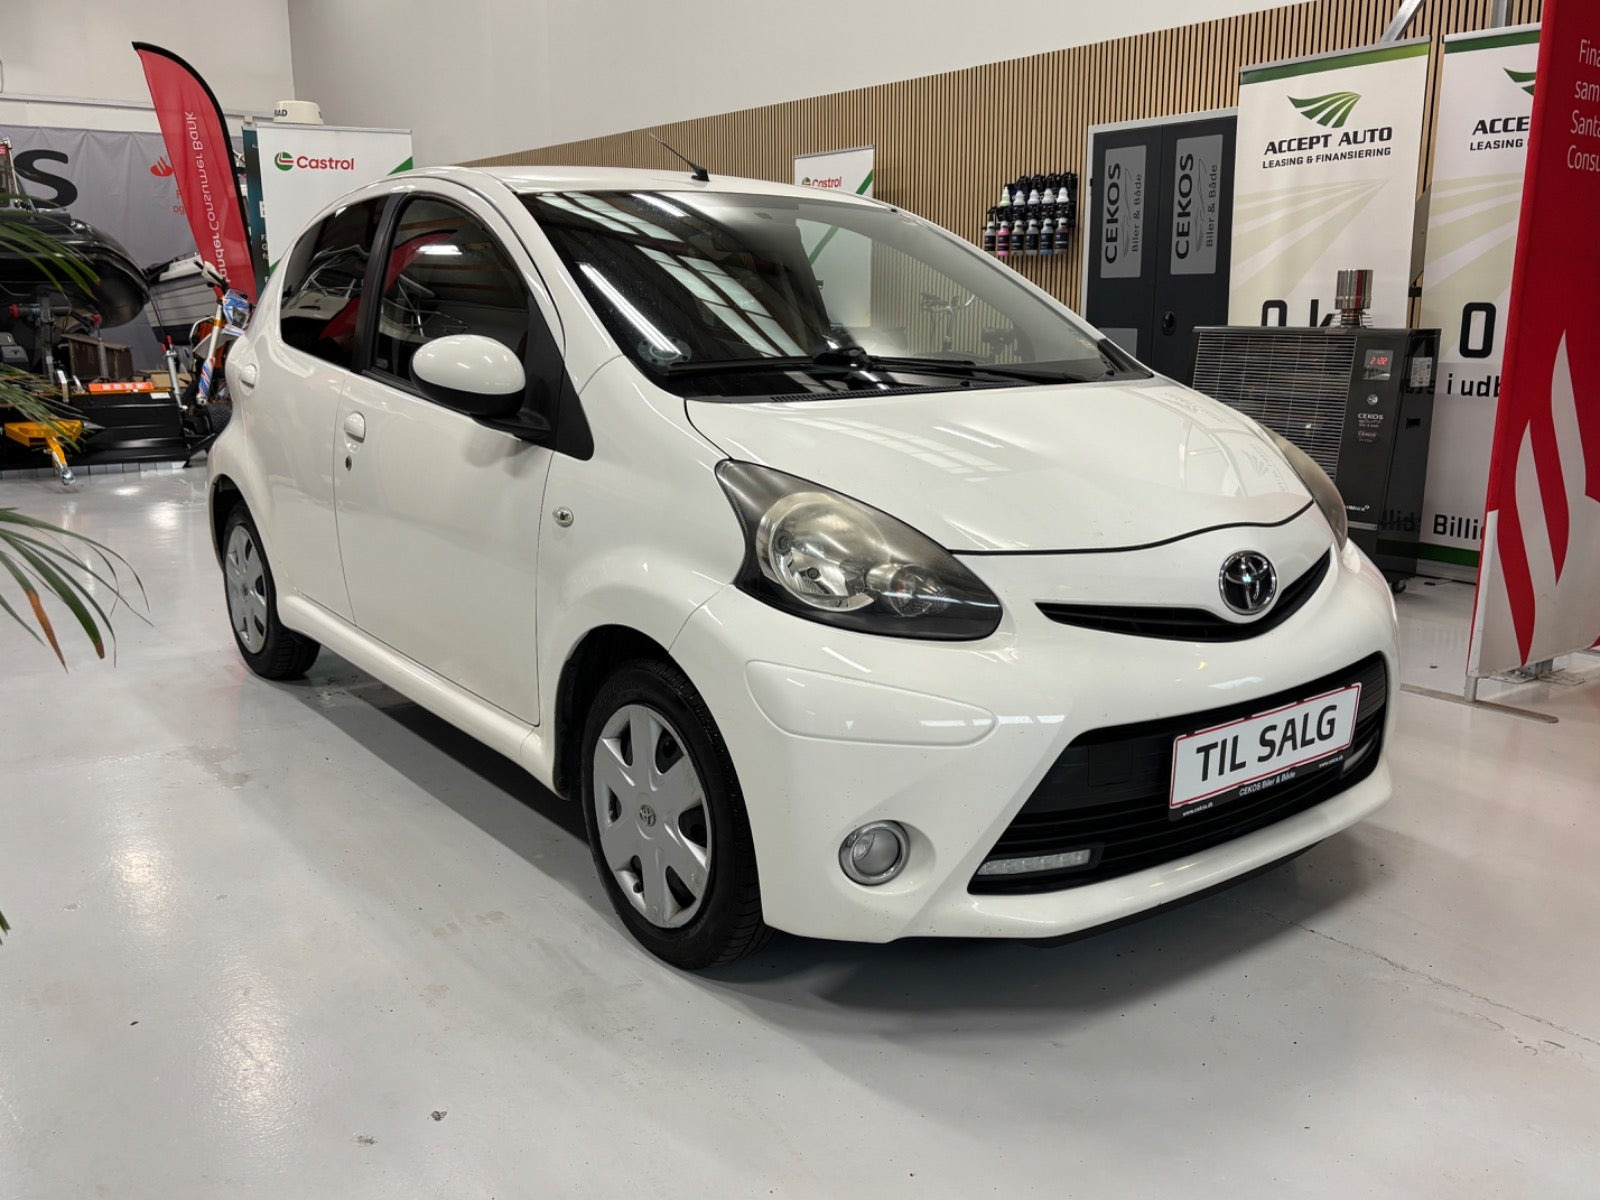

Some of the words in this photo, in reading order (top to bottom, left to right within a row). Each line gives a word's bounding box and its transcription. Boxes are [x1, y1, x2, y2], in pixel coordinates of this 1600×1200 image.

[1472, 116, 1530, 135] ACCE
[1263, 134, 1333, 155] ACCEPT
[1338, 127, 1393, 146] AUTO
[1470, 138, 1524, 151] LEASING
[296, 155, 355, 171] Castrol
[1262, 156, 1304, 169] LEASING
[1306, 155, 1314, 164] &
[1315, 147, 1392, 163] FINANSIERING
[812, 176, 842, 188] Castrol
[1105, 162, 1121, 264] CEKOS
[1175, 153, 1194, 260] CEKOS
[1207, 203, 1216, 213] &
[1447, 373, 1453, 394] i
[1433, 514, 1484, 540] Billi
[1196, 735, 1247, 782] TIL
[1257, 704, 1338, 762] SALG
[1238, 782, 1261, 796] CEKOS
[1261, 778, 1275, 789] Biler
[1275, 776, 1281, 784] &
